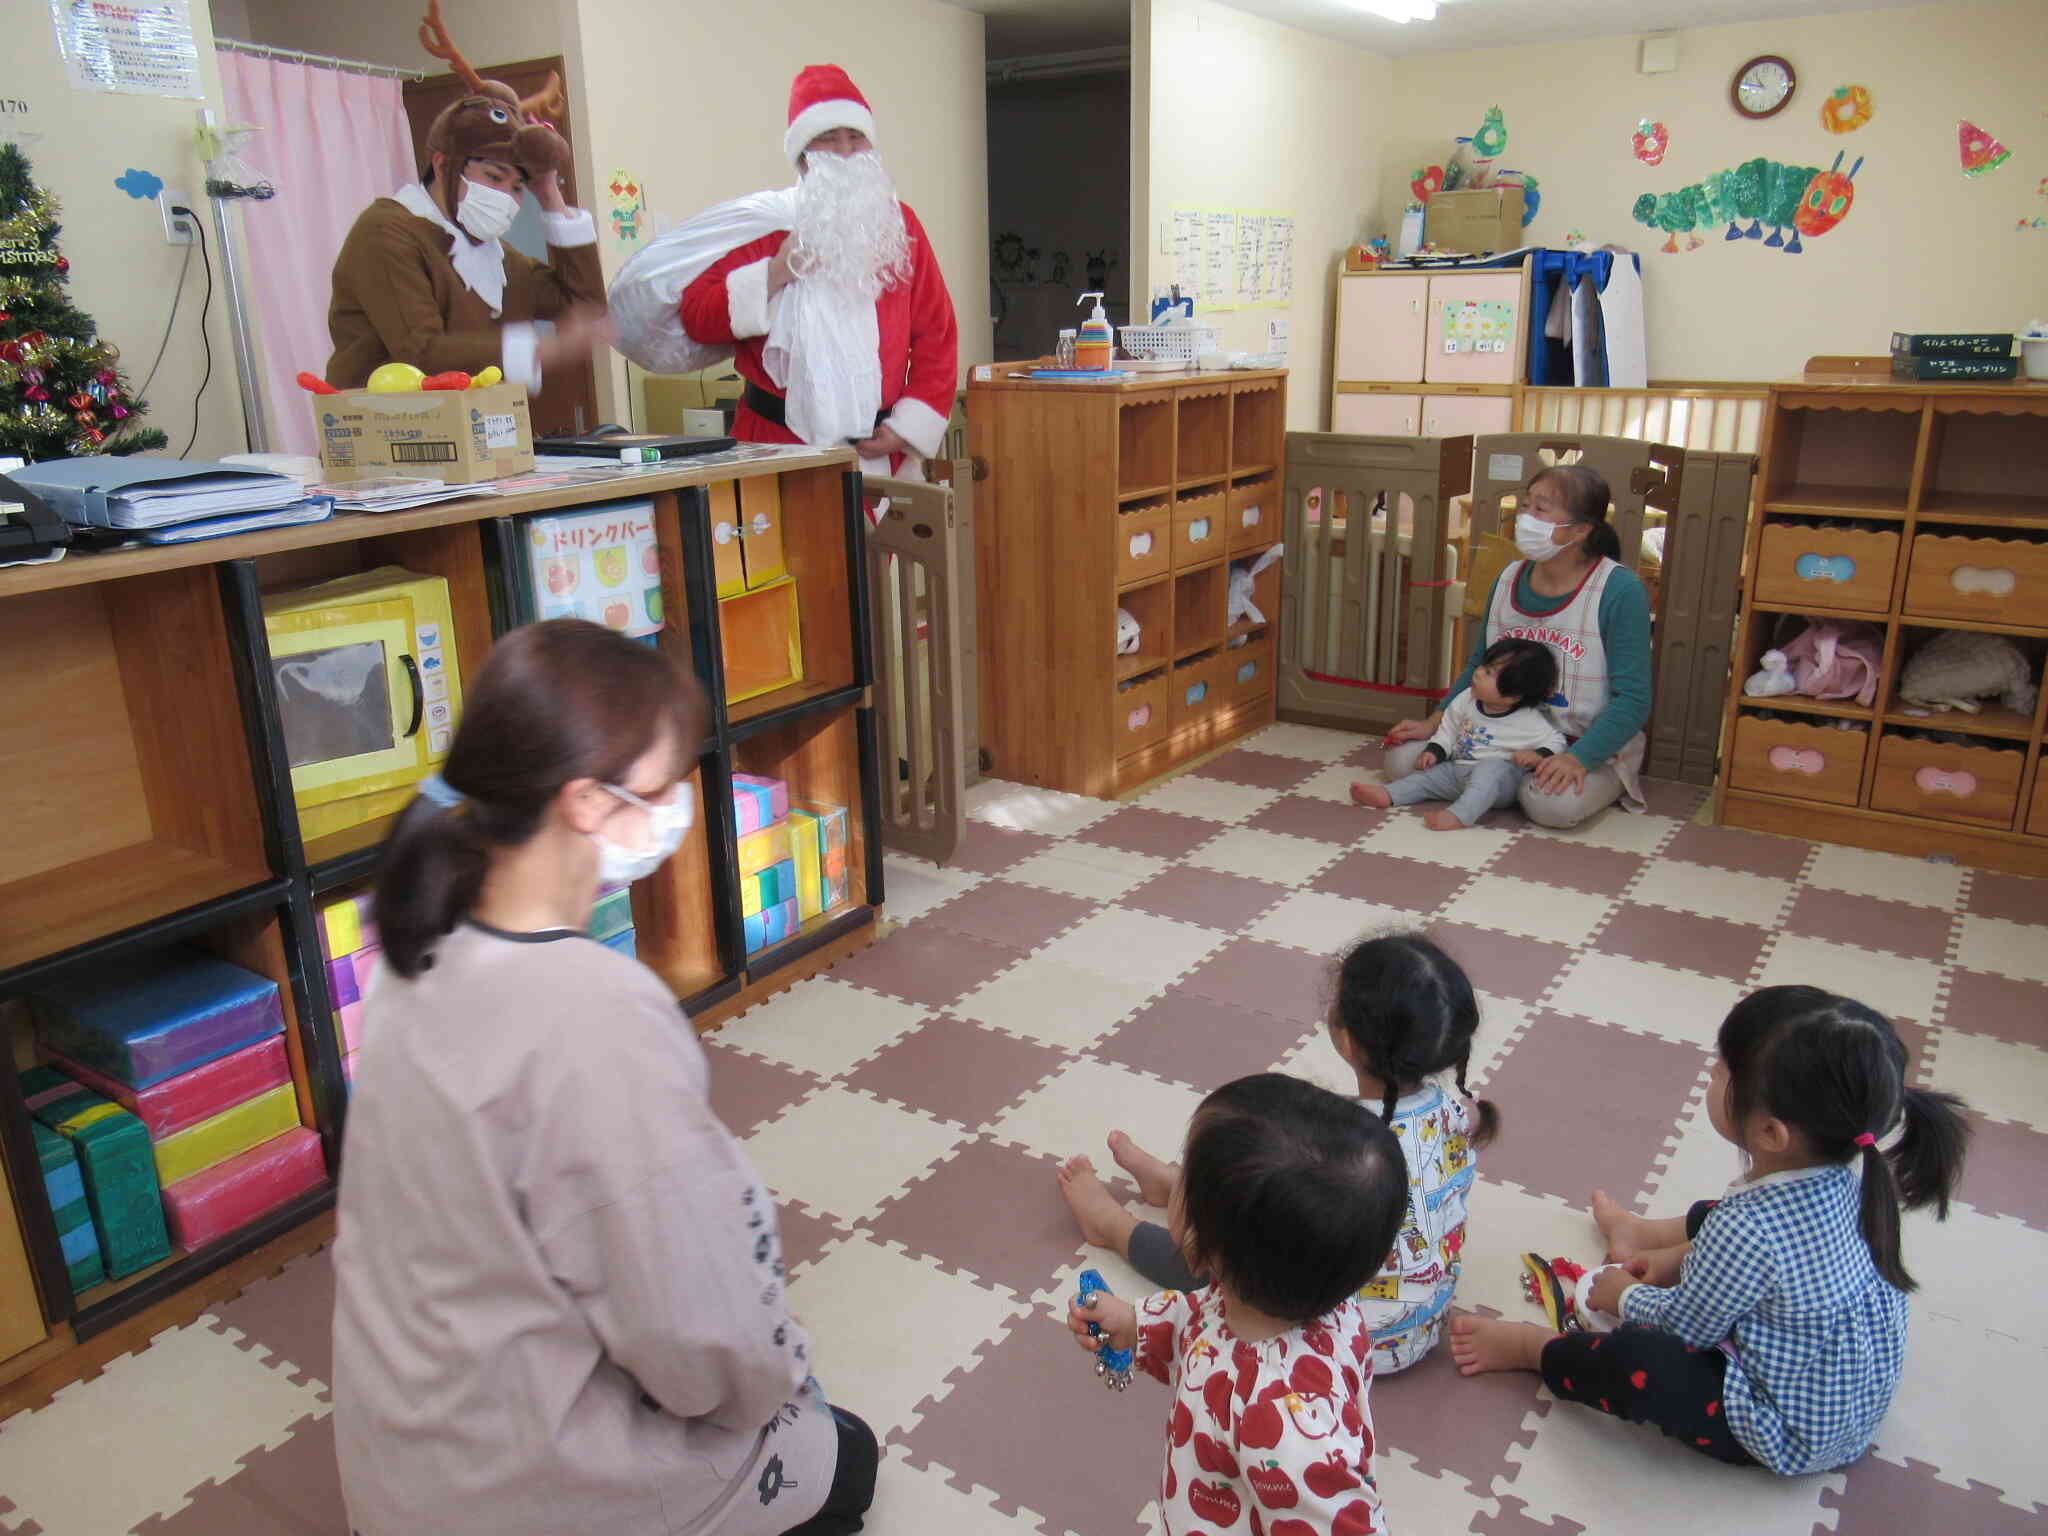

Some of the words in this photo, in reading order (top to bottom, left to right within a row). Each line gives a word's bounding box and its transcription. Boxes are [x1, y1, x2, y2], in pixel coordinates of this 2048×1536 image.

[553, 520, 650, 552] ドリンクバー
